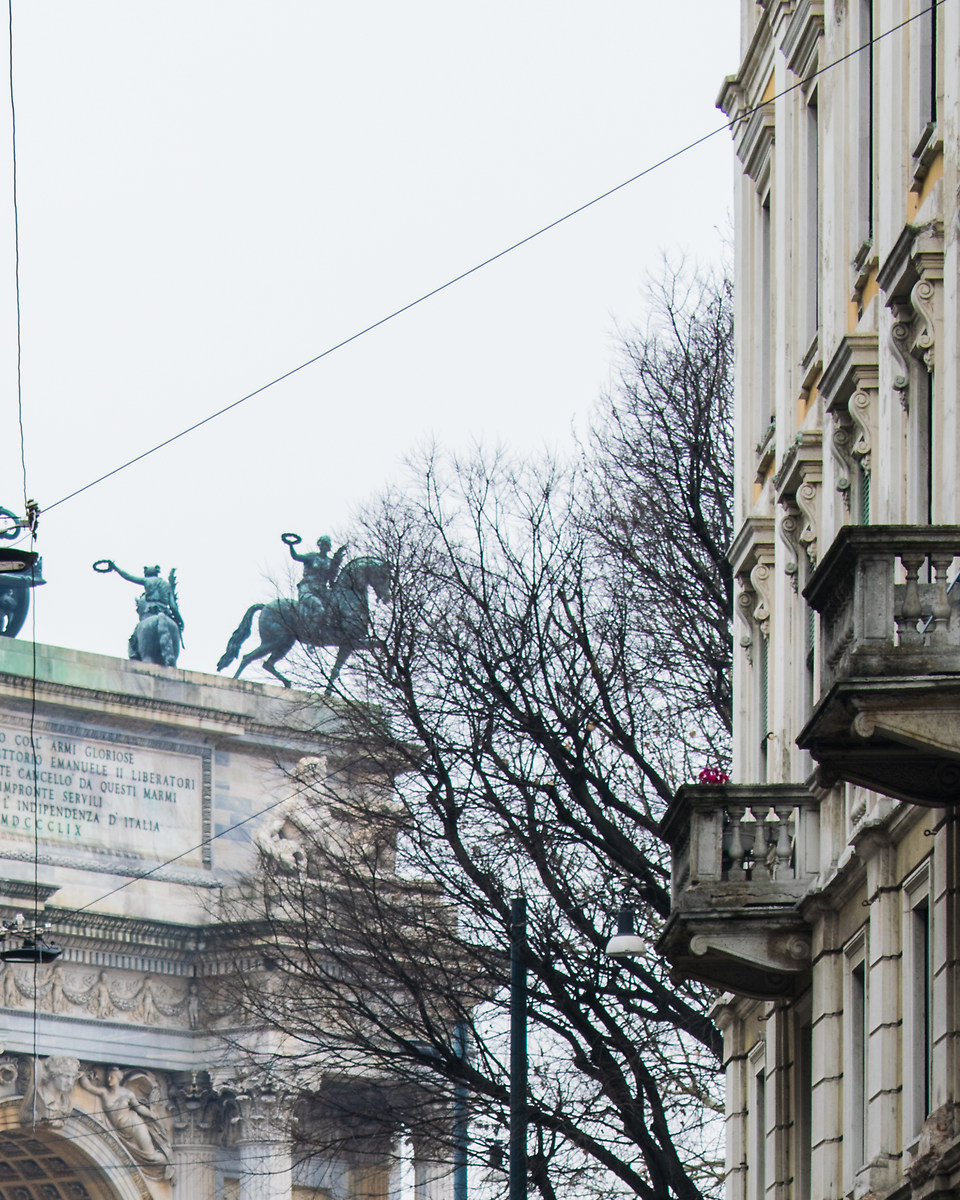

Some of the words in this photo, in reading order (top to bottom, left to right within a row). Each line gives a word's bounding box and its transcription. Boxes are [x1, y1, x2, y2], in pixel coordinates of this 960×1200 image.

[51, 741, 76, 755] ARMI
[84, 746, 135, 765] GLORIOSE
[50, 756, 108, 777] EMANUELE
[115, 767, 123, 779] II
[131, 769, 195, 790] LIBERATORI
[0, 781, 55, 800] IMPRONTE
[62, 790, 103, 808] SERVILI
[79, 777, 92, 790] DA
[100, 781, 136, 797] QUESTI
[143, 787, 177, 803] MARMI
[17, 799, 100, 824] INDIPENDENZA
[124, 816, 161, 832] ITALIA
